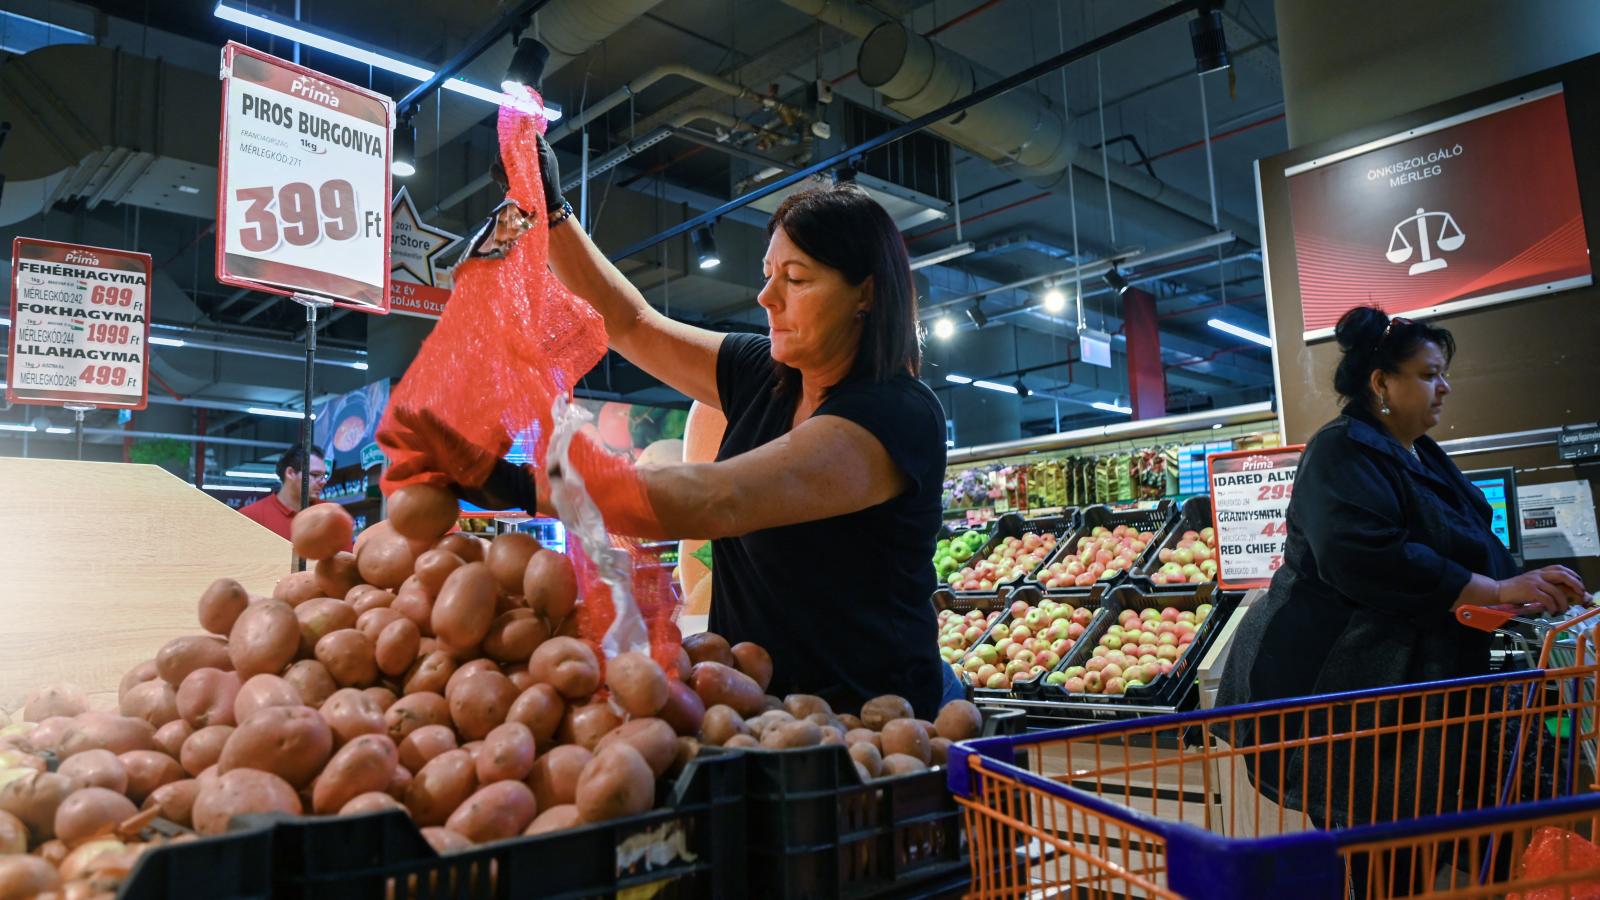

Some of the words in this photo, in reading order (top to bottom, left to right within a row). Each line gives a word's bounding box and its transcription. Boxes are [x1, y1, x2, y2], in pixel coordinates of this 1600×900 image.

[290, 80, 340, 108] Prima
[242, 93, 293, 129] PIROS
[298, 110, 383, 158] BURGONYA
[300, 138, 317, 152] 1kg
[239, 143, 302, 168] MÉRLEGKÓD:271
[1389, 164, 1442, 189] MÉRLEG
[235, 178, 358, 253] 399
[365, 210, 382, 238] Ft
[395, 221, 412, 232] 2021
[65, 253, 100, 266] Prima
[19, 262, 146, 285] FEHÉRHAGYMA
[23, 287, 83, 304] MÉRLEGKÓD:242
[90, 284, 133, 307] 699
[134, 301, 143, 312] Ft
[403, 284, 416, 296] ÉV
[17, 303, 145, 324] FOKHAGYMA
[18, 326, 75, 345] MÉRLEGKÓD:244
[86, 323, 130, 345] 1999
[130, 335, 140, 345] Ft
[17, 344, 141, 363] LILAHAGYMA
[20, 371, 77, 387] MÉRLEGKÓD:246
[79, 365, 127, 387] 499
[127, 377, 137, 387] Ft
[1242, 459, 1274, 471] Prima
[1214, 473, 1263, 487] IDARED
[1218, 508, 1282, 523] GRANNYSMITH
[1220, 544, 1243, 555] RED
[1245, 542, 1277, 554] CHIEF
